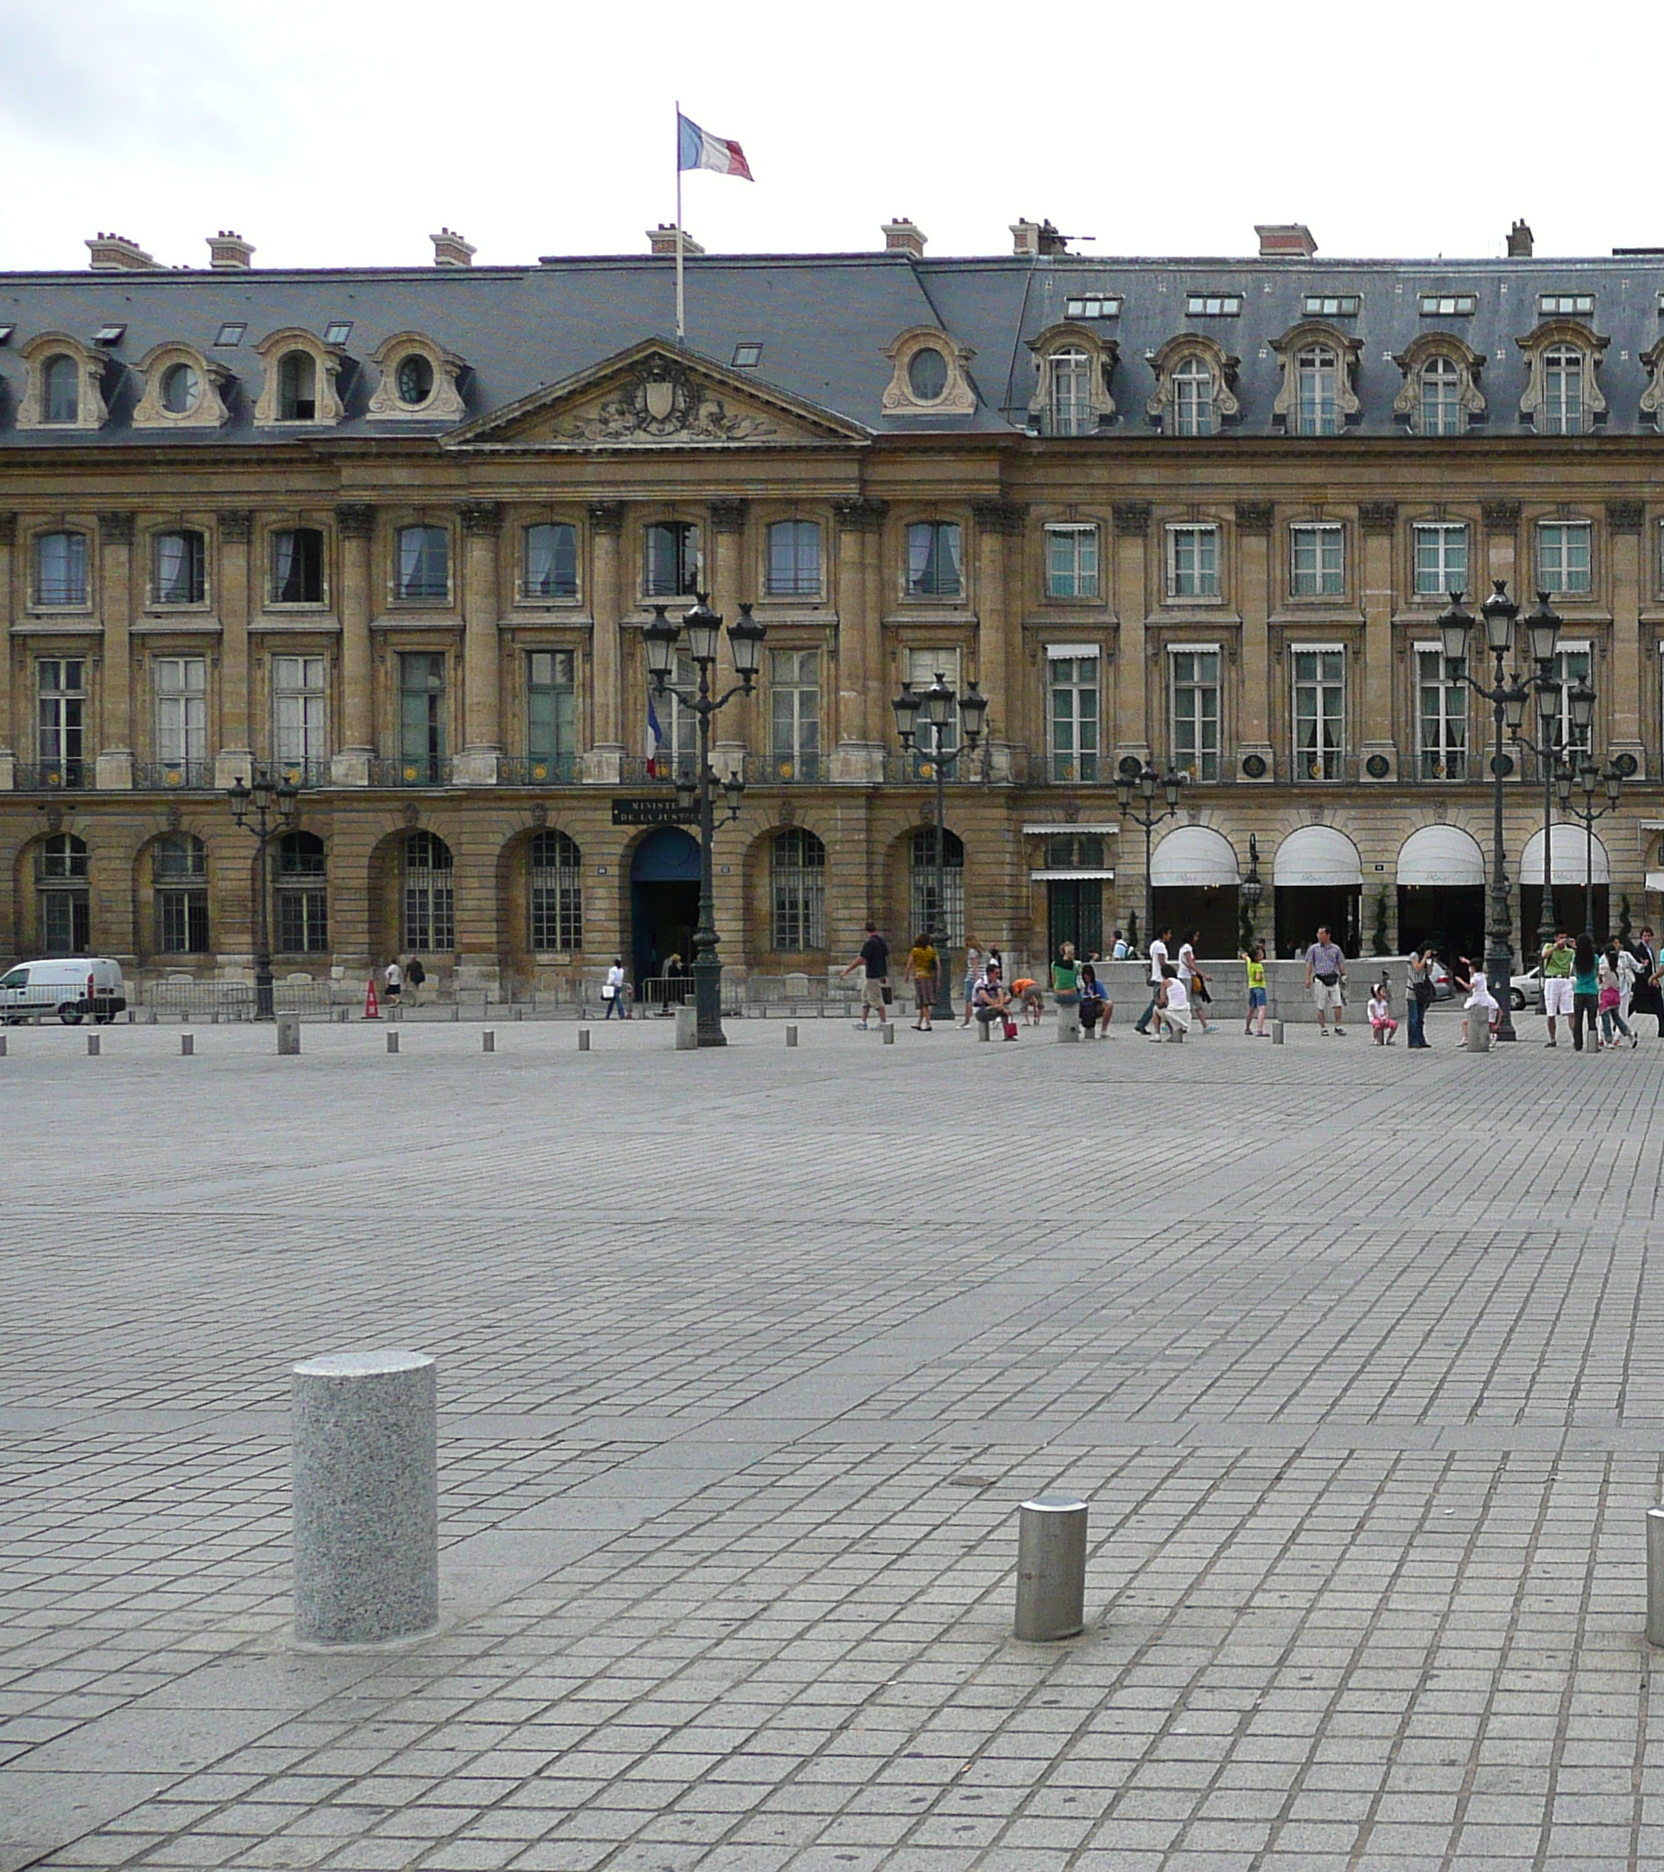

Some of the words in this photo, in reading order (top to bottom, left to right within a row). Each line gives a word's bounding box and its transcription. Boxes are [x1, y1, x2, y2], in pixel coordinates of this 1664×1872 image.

[632, 801, 678, 810] MINISTE
[620, 813, 635, 821] DE
[640, 813, 653, 821] LA
[657, 813, 702, 821] JUSTCE
